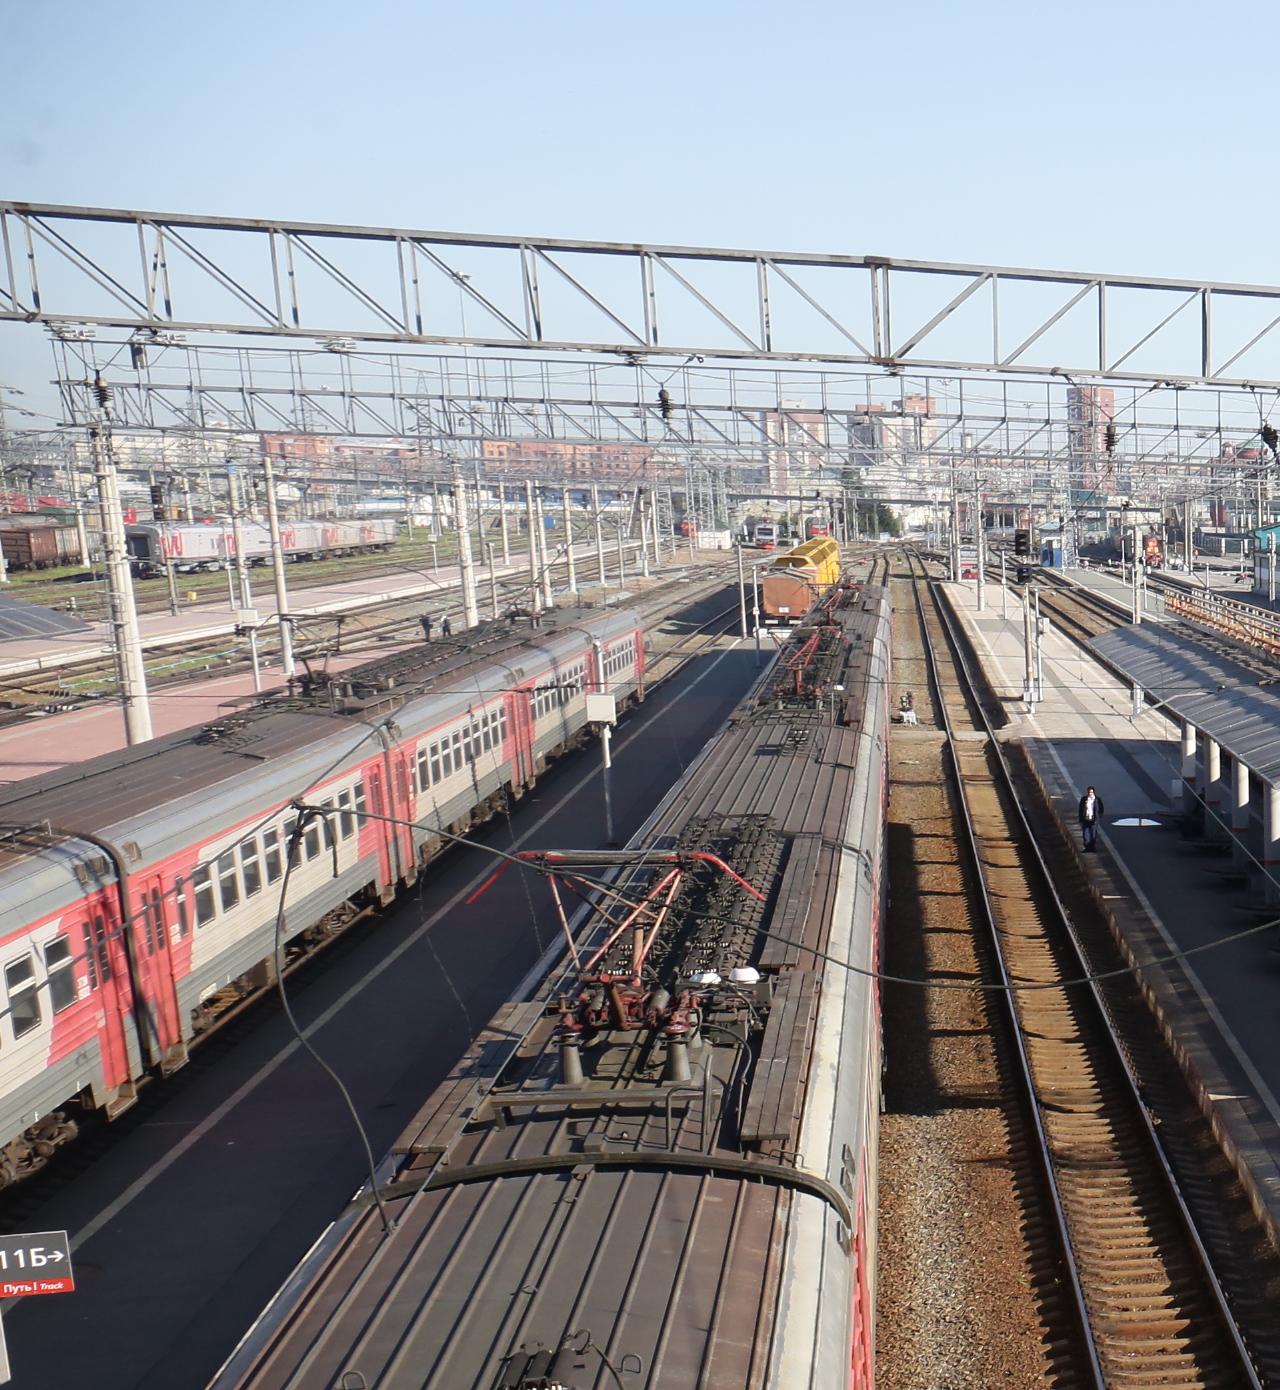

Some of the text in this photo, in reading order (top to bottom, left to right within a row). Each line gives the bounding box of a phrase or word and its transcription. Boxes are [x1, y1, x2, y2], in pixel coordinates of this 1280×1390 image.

[0, 1247, 48, 1270] 11Б
[3, 1281, 64, 1295] Путь Track
